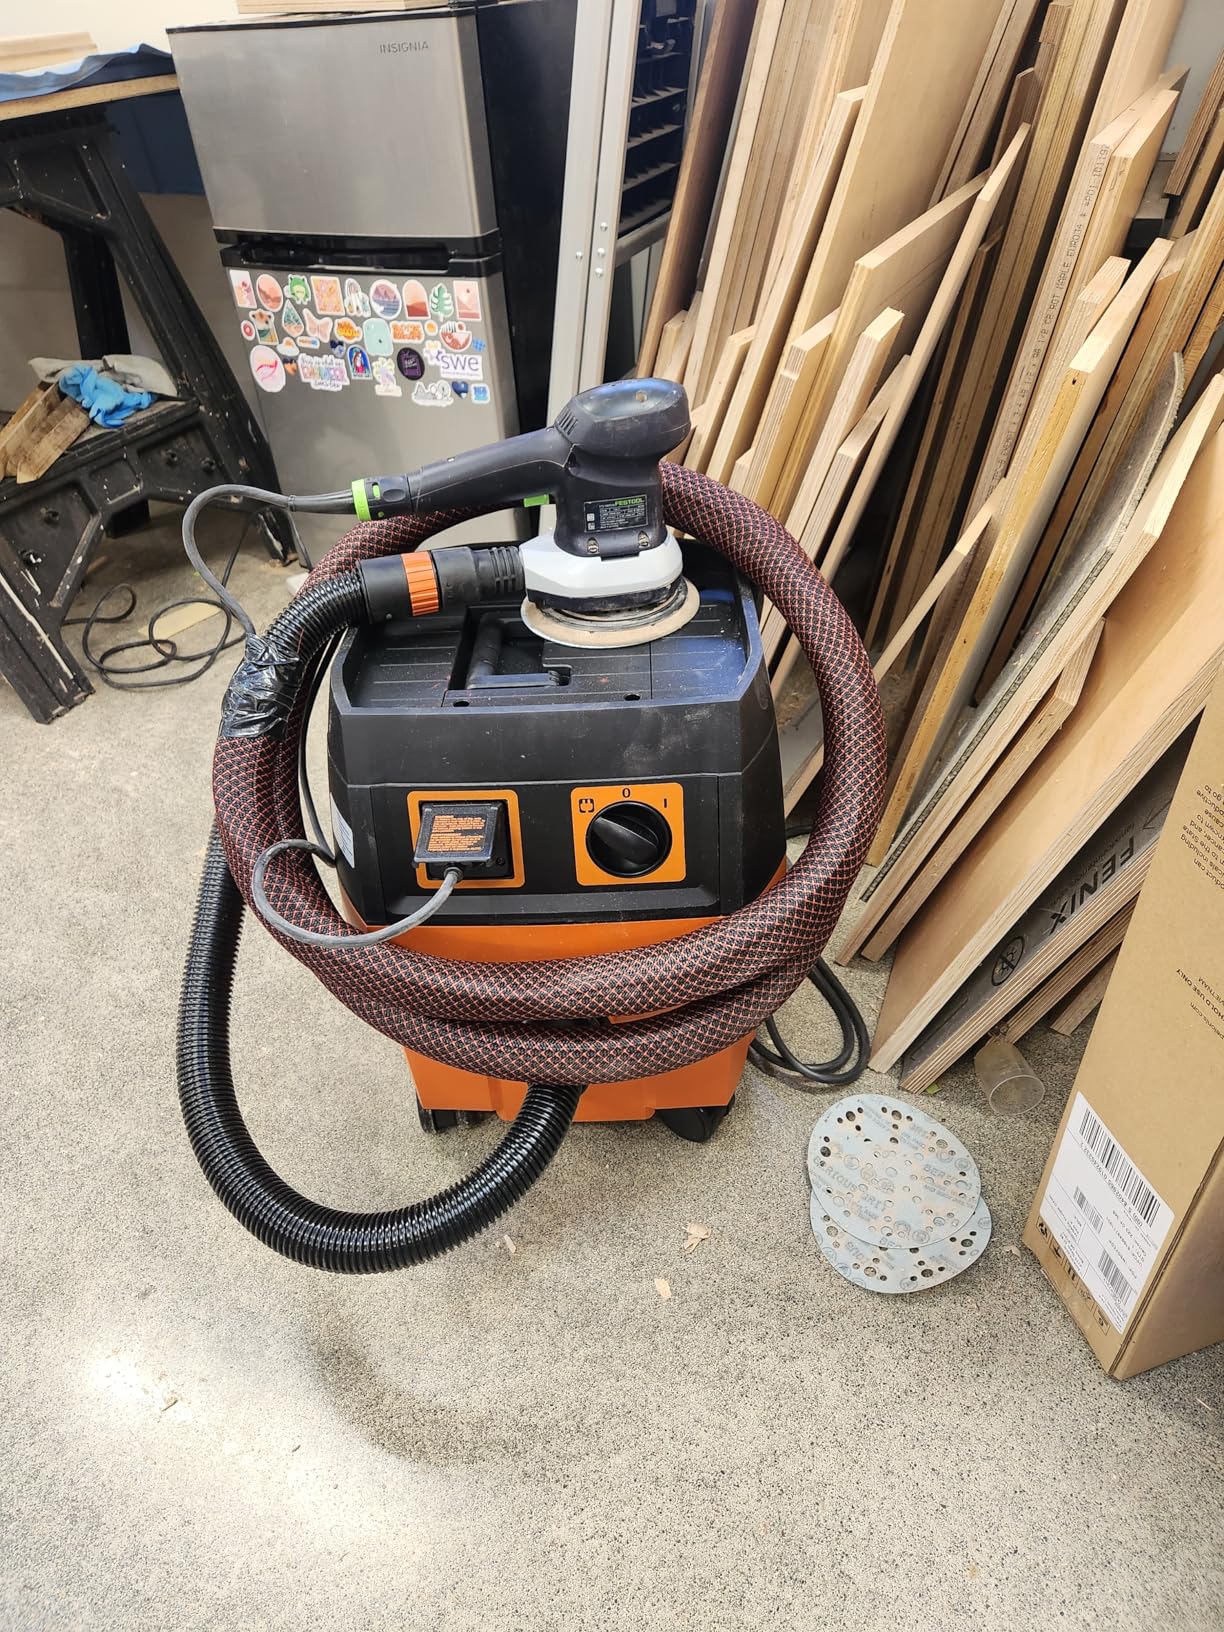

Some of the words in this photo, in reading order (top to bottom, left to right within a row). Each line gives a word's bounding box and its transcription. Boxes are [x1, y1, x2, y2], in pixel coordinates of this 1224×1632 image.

[379, 41, 429, 54] INSIGNIA
[1056, 261, 1072, 290] MAPLE
[614, 497, 645, 507] FESTOOL
[1181, 833, 1209, 862] including
[1046, 835, 1136, 935] FENIX
[1176, 968, 1193, 987] ONLY
[1192, 985, 1206, 1001] USE
